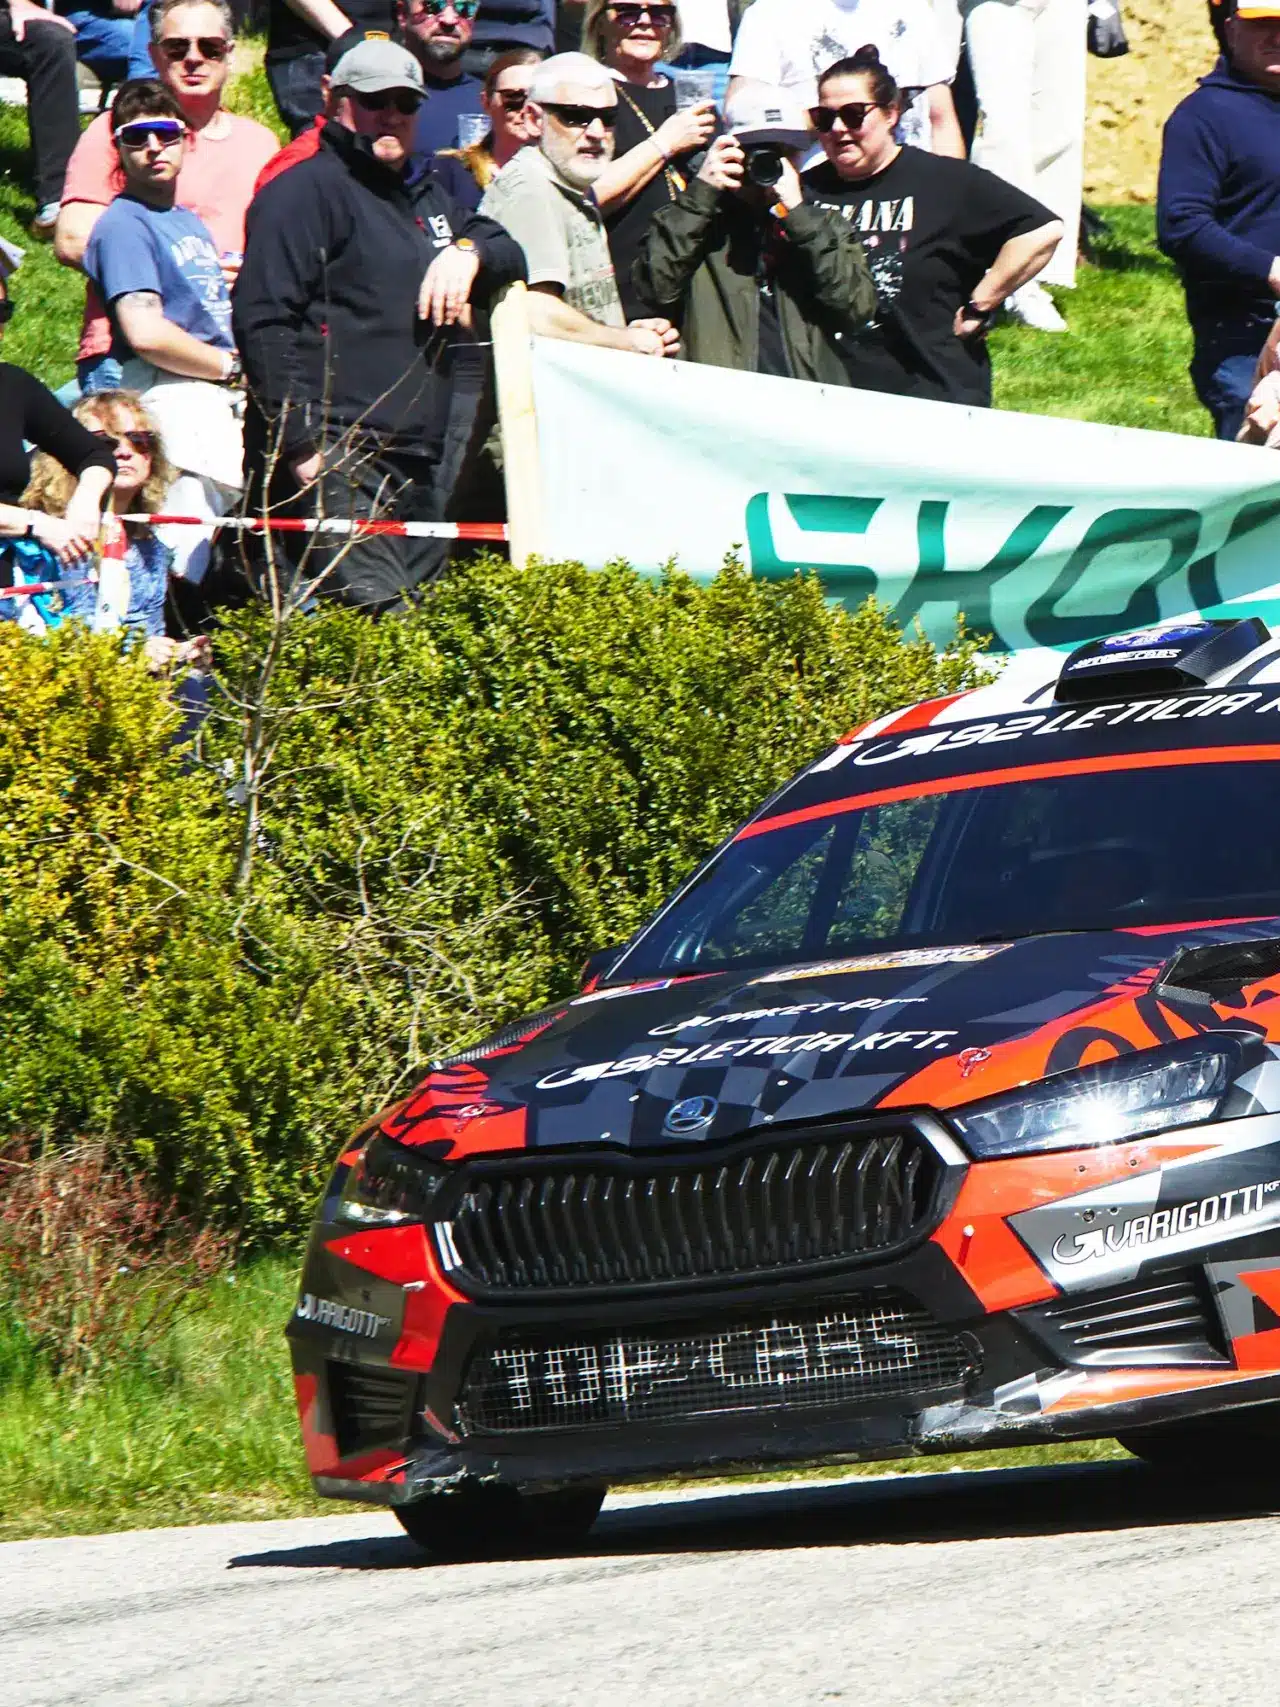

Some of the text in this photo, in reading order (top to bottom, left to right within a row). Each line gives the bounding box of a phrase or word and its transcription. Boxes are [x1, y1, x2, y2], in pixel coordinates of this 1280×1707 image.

[812, 195, 914, 232] VANA
[1035, 693, 1258, 736] LETICIA
[677, 1031, 855, 1065] LETICIA
[849, 1030, 959, 1052] KFT.
